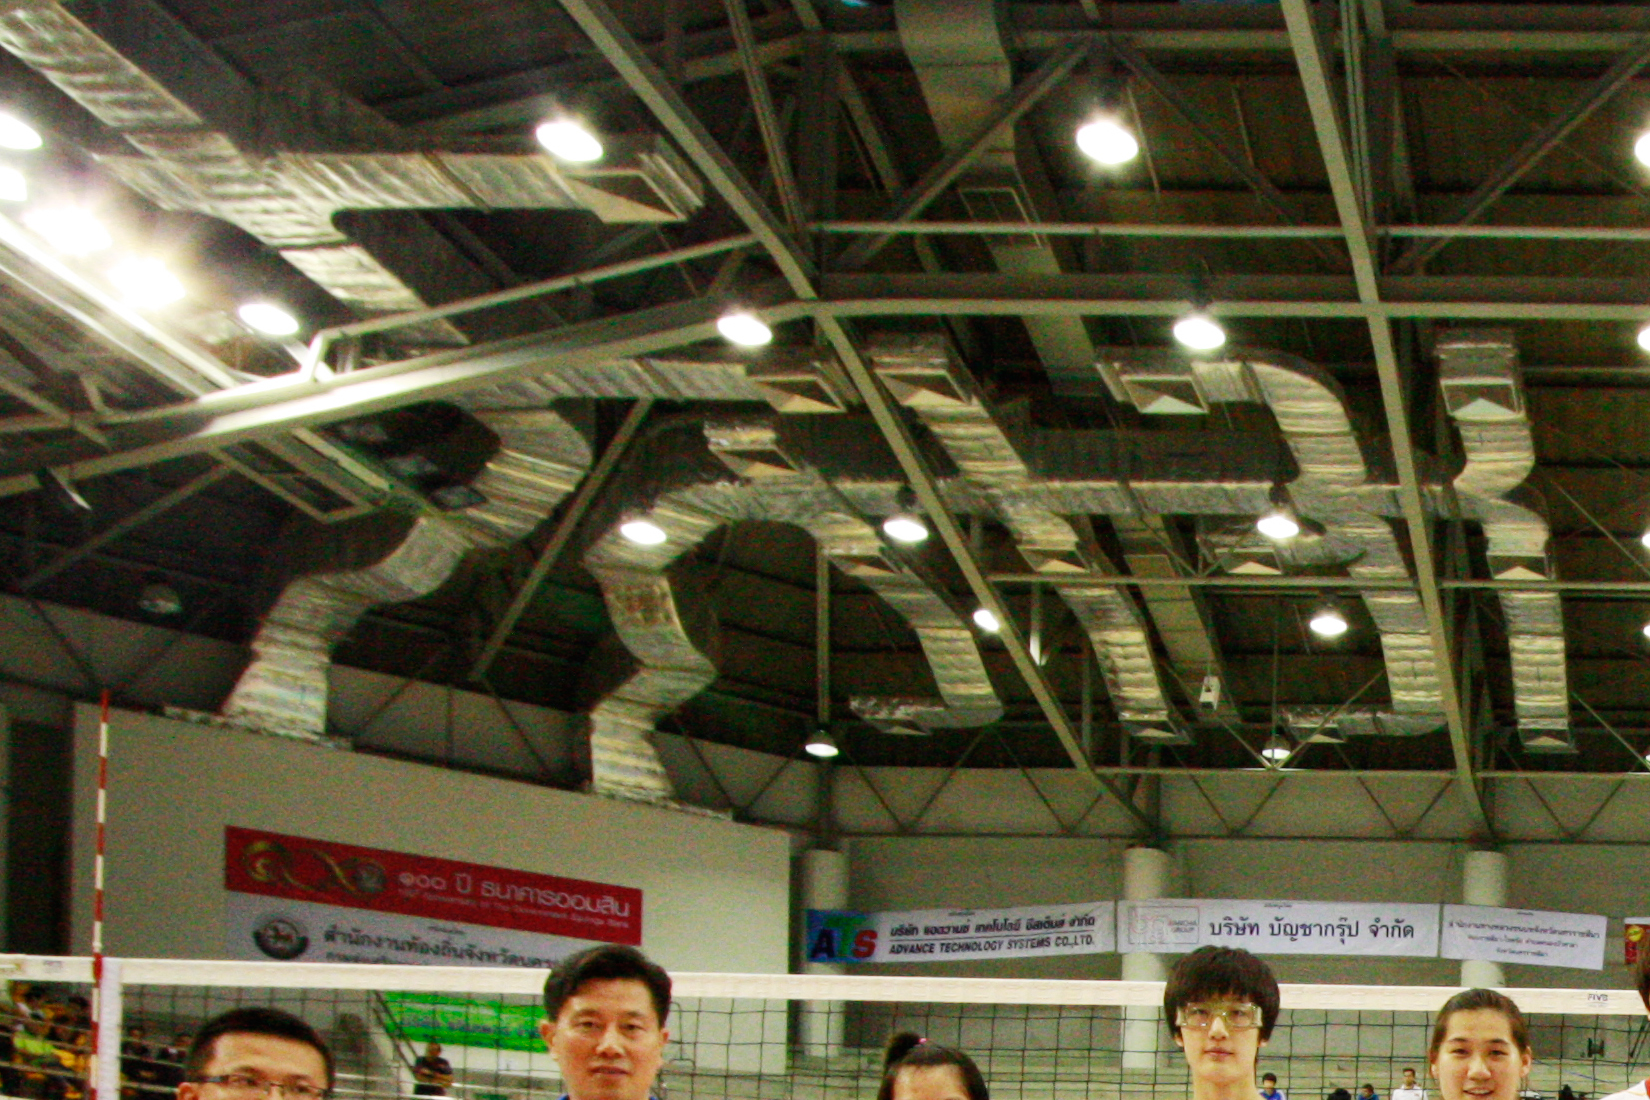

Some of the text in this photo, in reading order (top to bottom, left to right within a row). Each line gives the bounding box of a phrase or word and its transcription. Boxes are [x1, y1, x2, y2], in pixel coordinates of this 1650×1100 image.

[481, 881, 630, 917] ธนาคารออมสิน
[889, 942, 935, 954] ADVANCE
[940, 940, 1003, 953] TECHNOLOGY
[1007, 936, 1050, 949] SYSTEMS
[1209, 916, 1415, 945] บริษัท บัญชากรุ๊ป จำกัด
